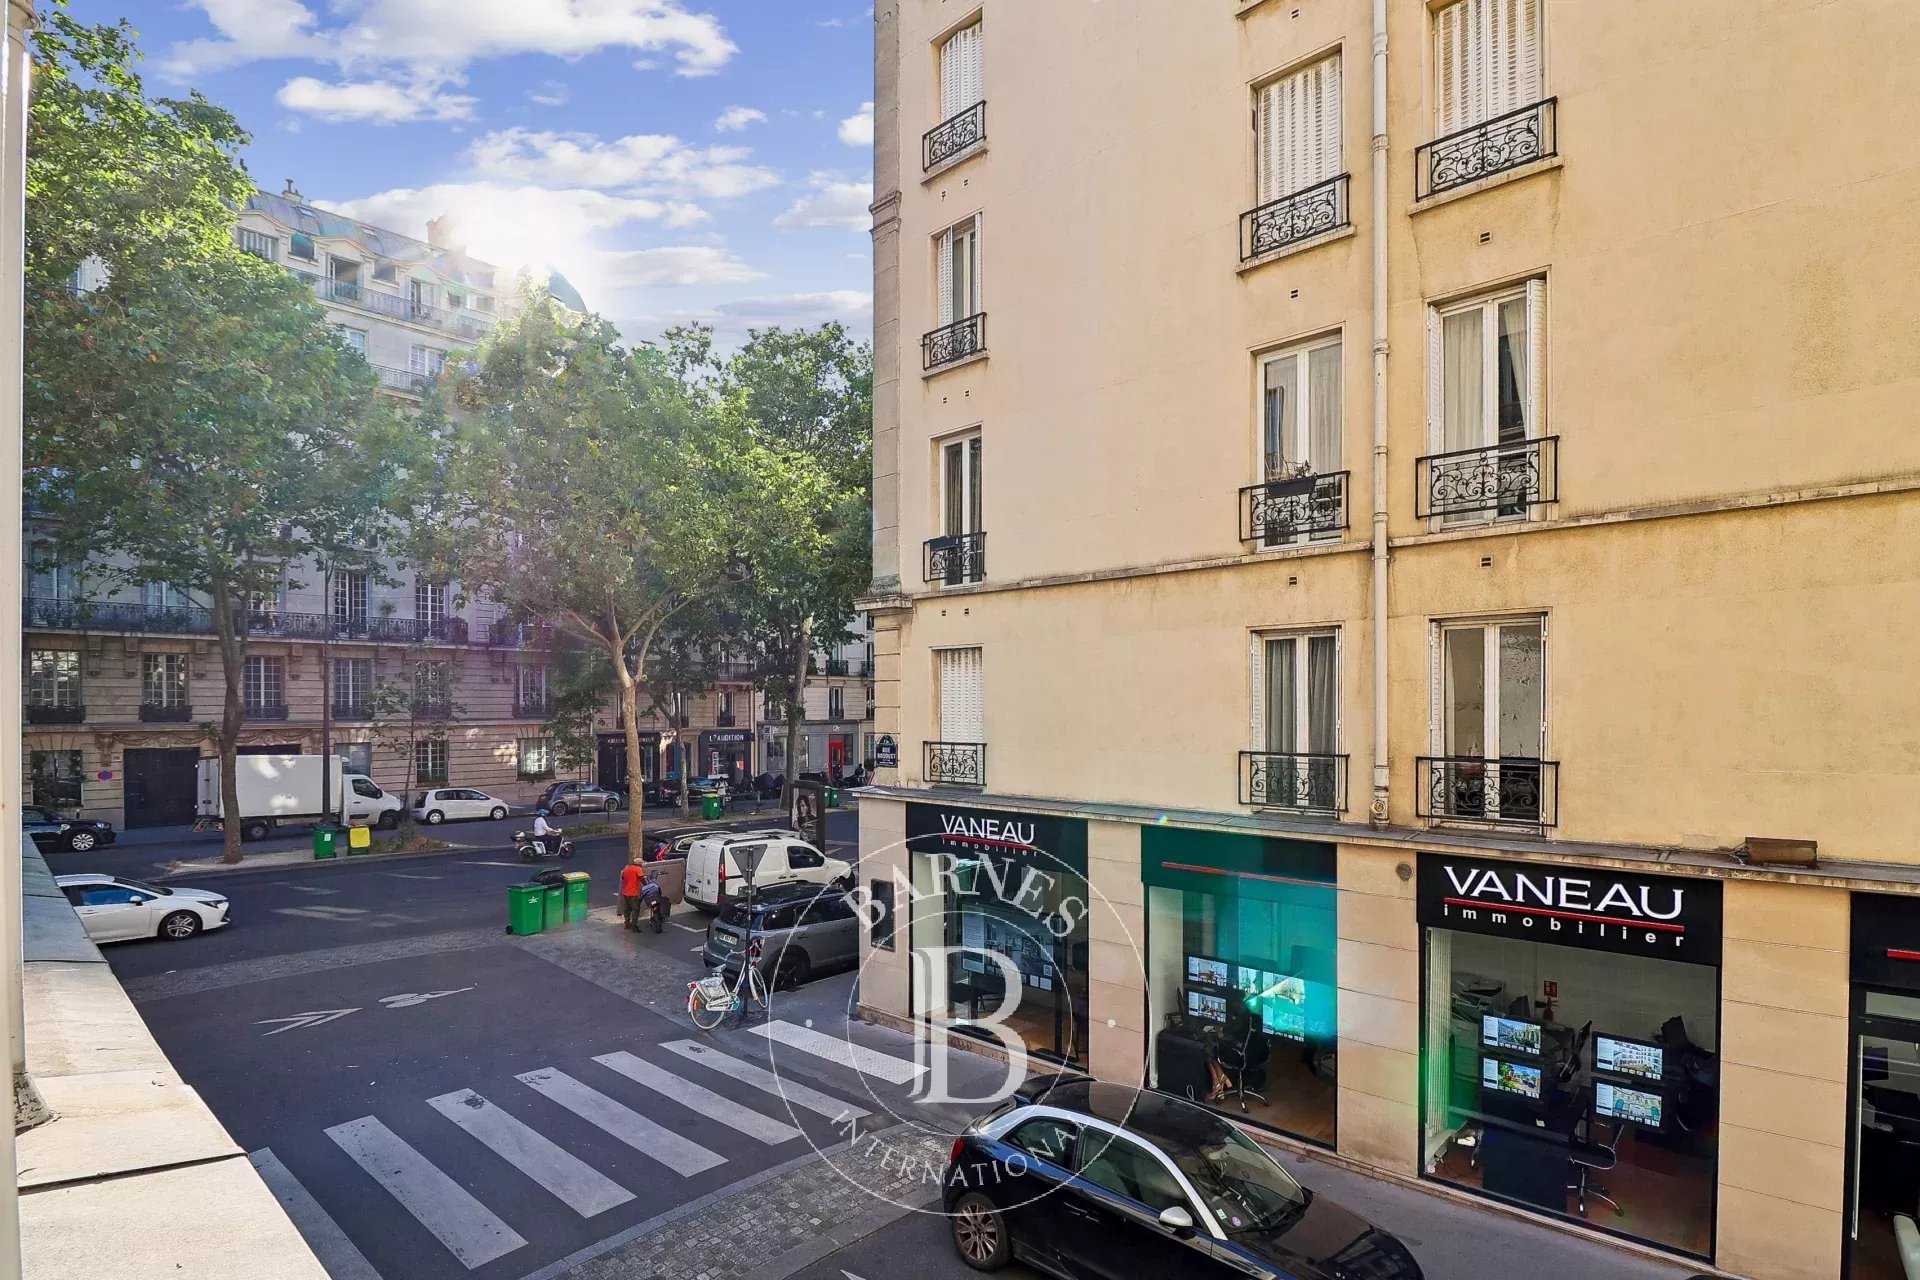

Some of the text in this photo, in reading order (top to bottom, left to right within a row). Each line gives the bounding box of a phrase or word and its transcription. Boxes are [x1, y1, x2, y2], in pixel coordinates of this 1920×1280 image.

[941, 813, 1035, 845] VANEAU
[942, 838, 1038, 857] immobilier
[1443, 865, 1684, 920] VANEAU
[1442, 904, 1684, 948] immobilier
